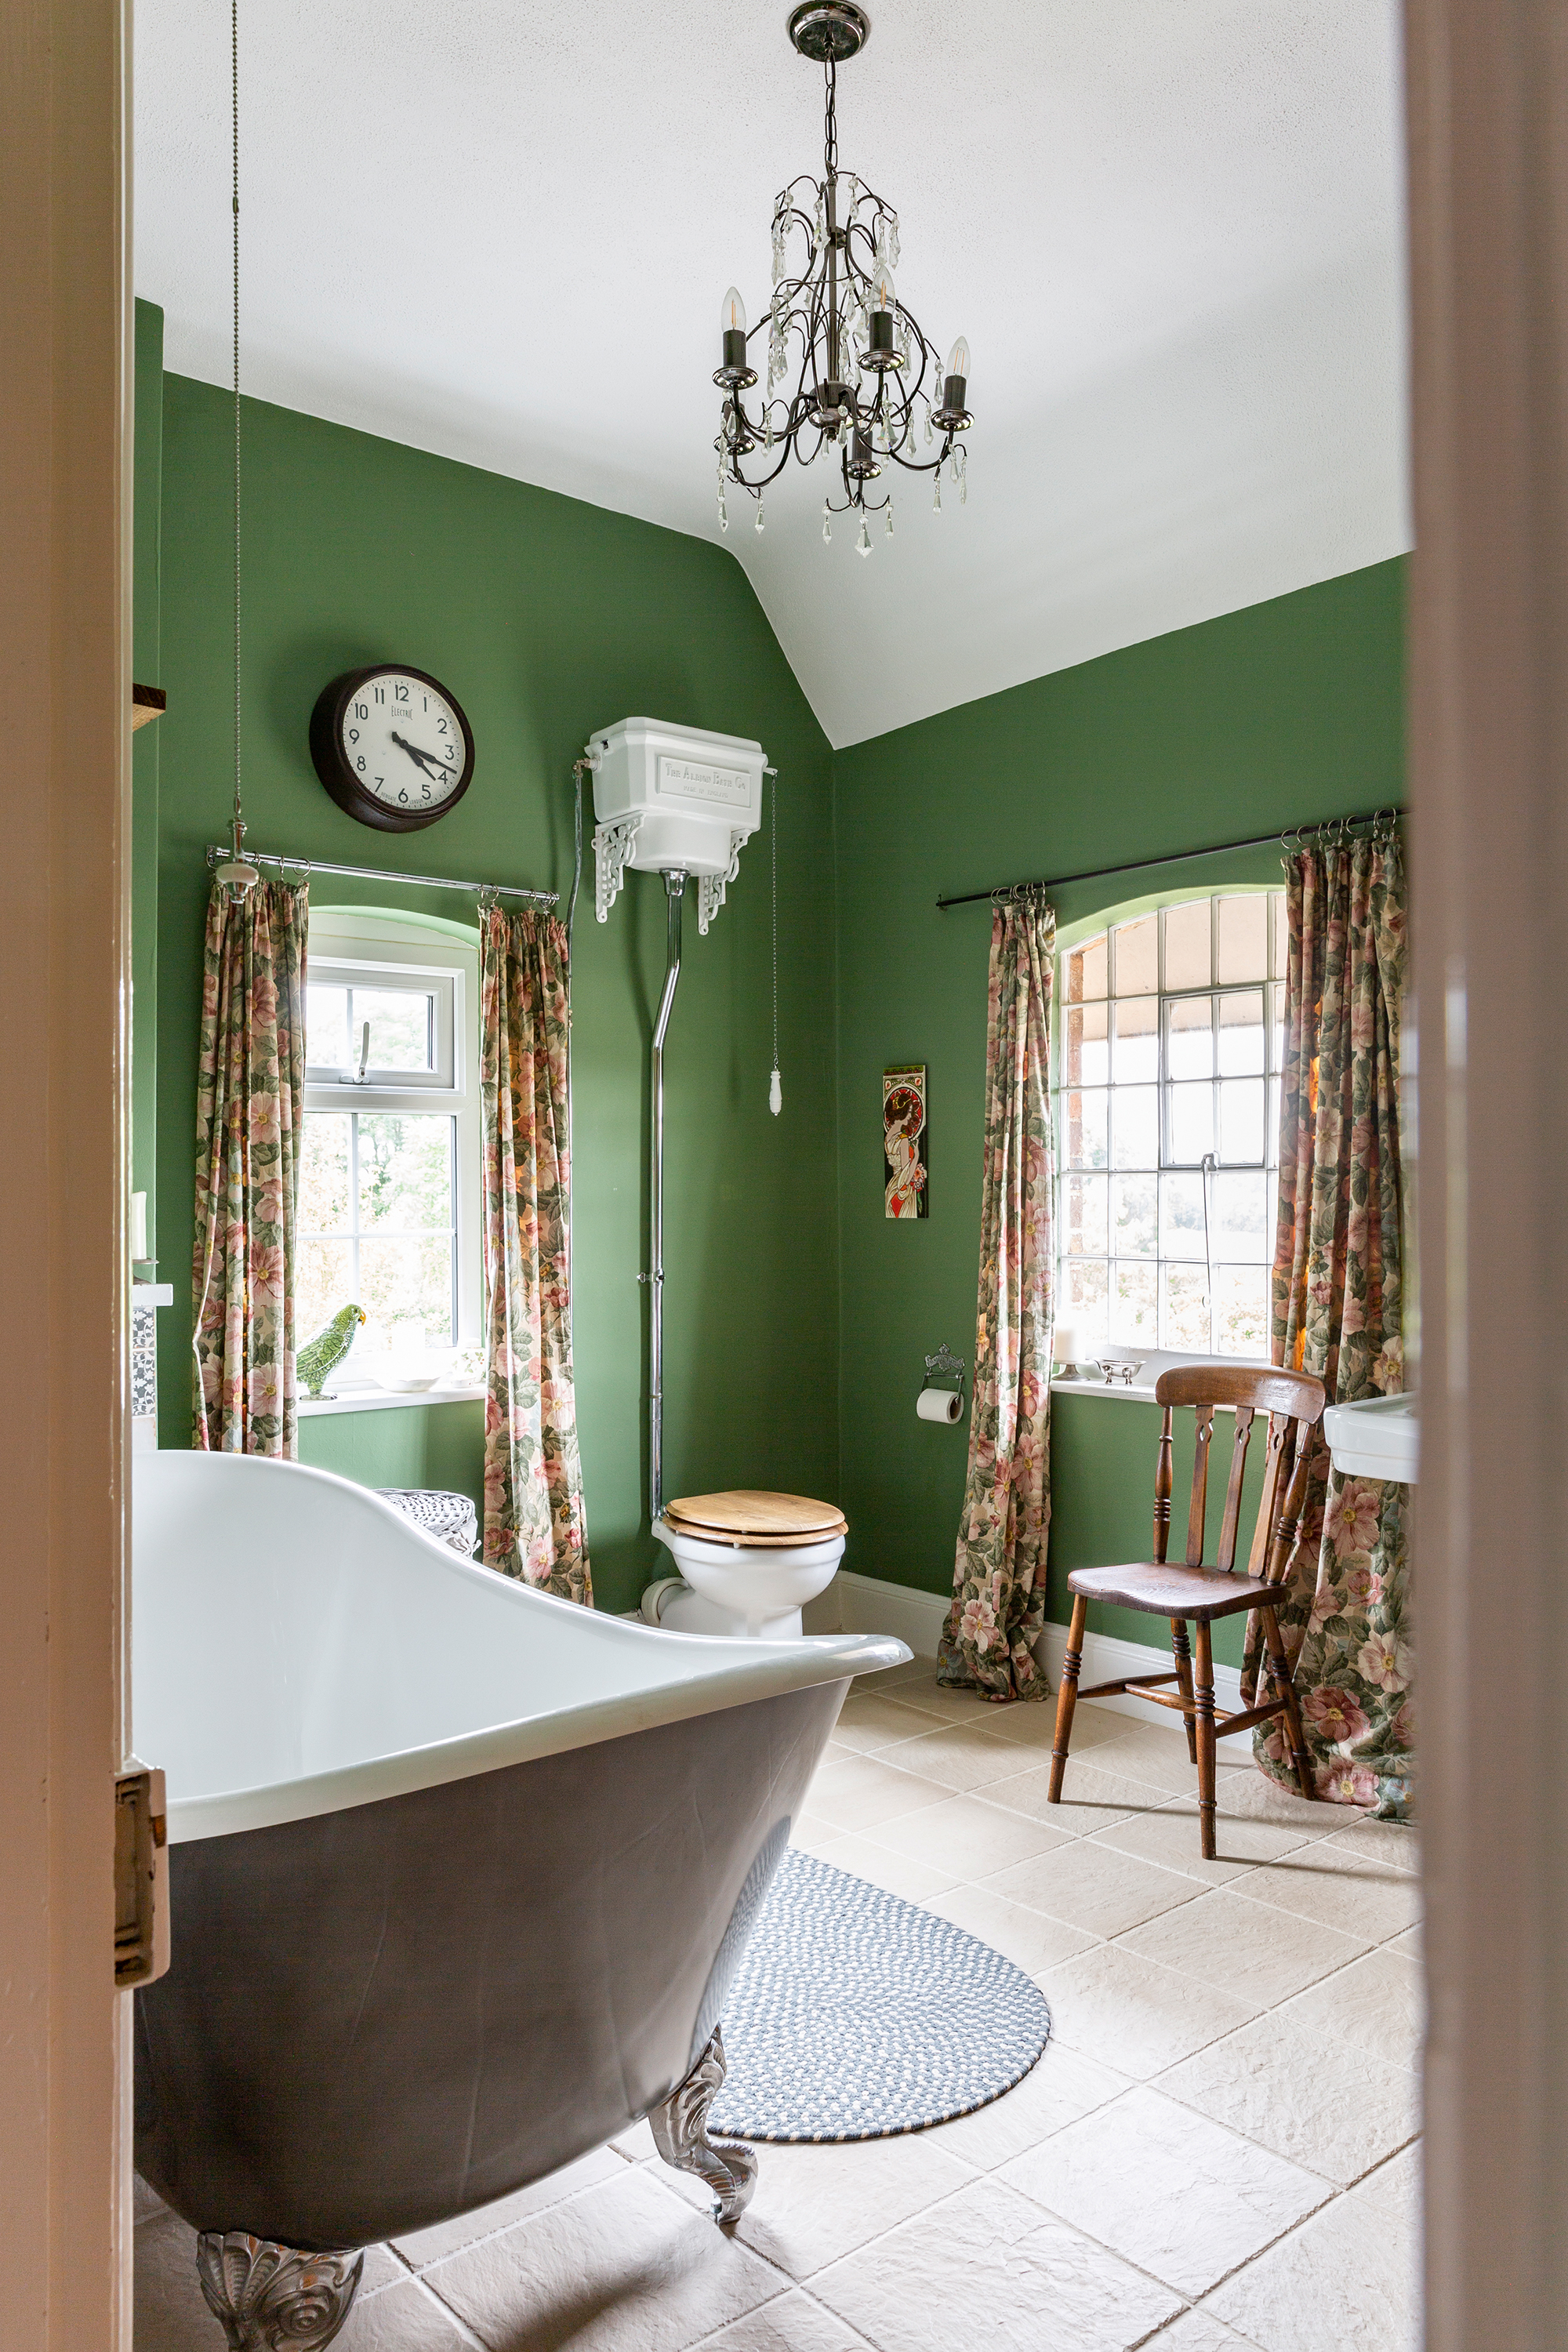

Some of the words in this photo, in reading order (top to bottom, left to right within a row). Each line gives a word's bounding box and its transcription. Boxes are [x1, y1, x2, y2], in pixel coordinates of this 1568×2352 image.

[375, 688, 385, 705] 11
[395, 684, 409, 702] 12
[355, 702, 368, 720] 10
[391, 705, 413, 720] ELECTRIC
[423, 696, 427, 713] 1
[437, 718, 448, 735] 2
[349, 728, 360, 745] 9
[445, 744, 455, 760] 3
[357, 756, 366, 771] 8
[375, 777, 384, 793] 7
[437, 770, 448, 785] 4
[381, 792, 397, 802] NEWGATE
[398, 788, 408, 804] 6
[422, 784, 431, 800] 5
[707, 789, 728, 799] ENGLAND
